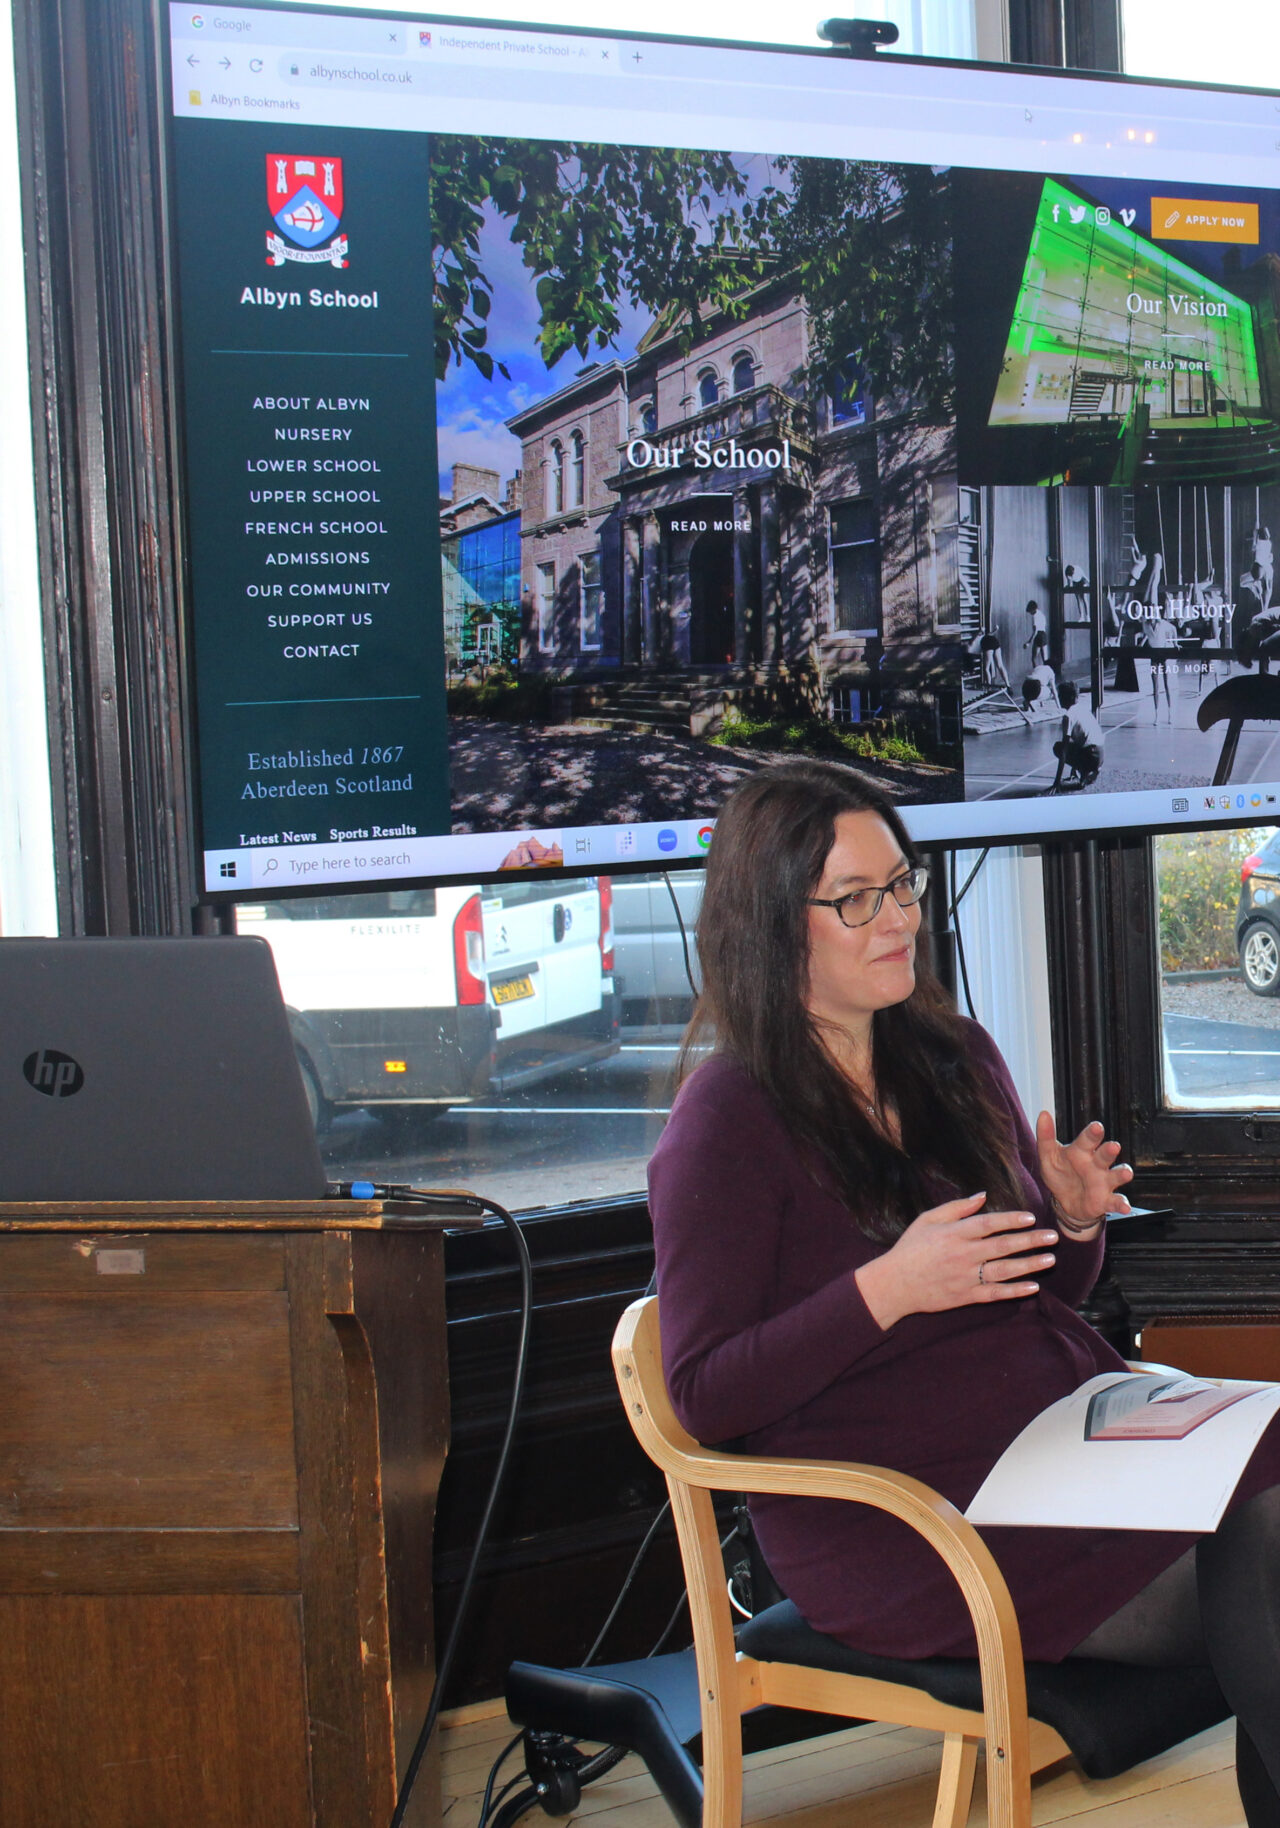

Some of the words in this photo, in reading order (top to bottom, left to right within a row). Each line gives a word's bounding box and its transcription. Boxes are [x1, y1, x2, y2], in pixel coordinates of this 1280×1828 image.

[213, 17, 252, 33] Google
[439, 35, 501, 51] Independent
[503, 40, 536, 54] Private
[537, 43, 570, 57] School
[309, 63, 413, 86] albynschool.co.uk
[210, 93, 241, 108] Albyn
[243, 96, 301, 111] Bookmarks
[1185, 215, 1220, 226] APPLY
[1221, 216, 1246, 228] NOW
[240, 286, 302, 309] Albyn
[309, 288, 379, 308] School
[1126, 292, 1164, 316] Our
[1167, 294, 1229, 318] Vision
[1144, 359, 1175, 371] READ
[1179, 360, 1211, 372] MORE
[252, 396, 311, 410] ABOUT
[316, 398, 370, 411] ALBYN
[274, 428, 353, 441] NURSERY
[626, 438, 685, 470] Our
[693, 438, 792, 470] School
[246, 459, 308, 473] LOWER
[313, 460, 382, 473] SCHOOL
[249, 490, 307, 504] UPPER
[312, 490, 381, 503] SCHOOL
[245, 522, 314, 535] FRENCH
[319, 521, 388, 534] SCHOOL
[670, 520, 708, 532] READ
[713, 520, 752, 531] MORE
[265, 551, 371, 565] ADMISSIONS
[246, 584, 284, 598] OUR
[288, 582, 391, 597] COMMUNITY
[1126, 599, 1164, 622] Our
[1168, 598, 1237, 624] History
[267, 613, 346, 628] SUPPORT
[351, 613, 374, 626] US
[283, 644, 361, 659] CONTACT
[1150, 663, 1181, 675] READ
[1183, 662, 1216, 674] MORE
[247, 747, 355, 771] Established
[360, 745, 404, 766] 1867
[240, 779, 330, 800] Aberdeen
[335, 773, 414, 795] Scotland
[239, 833, 280, 847] Latest
[282, 830, 318, 845] News
[329, 827, 370, 843] Sports
[371, 823, 418, 838] Results
[288, 859, 320, 875] Type
[321, 857, 352, 870] here
[354, 856, 368, 869] to
[369, 851, 412, 867] search
[349, 923, 422, 936] FLEXILITE
[33, 1049, 77, 1098] hp
